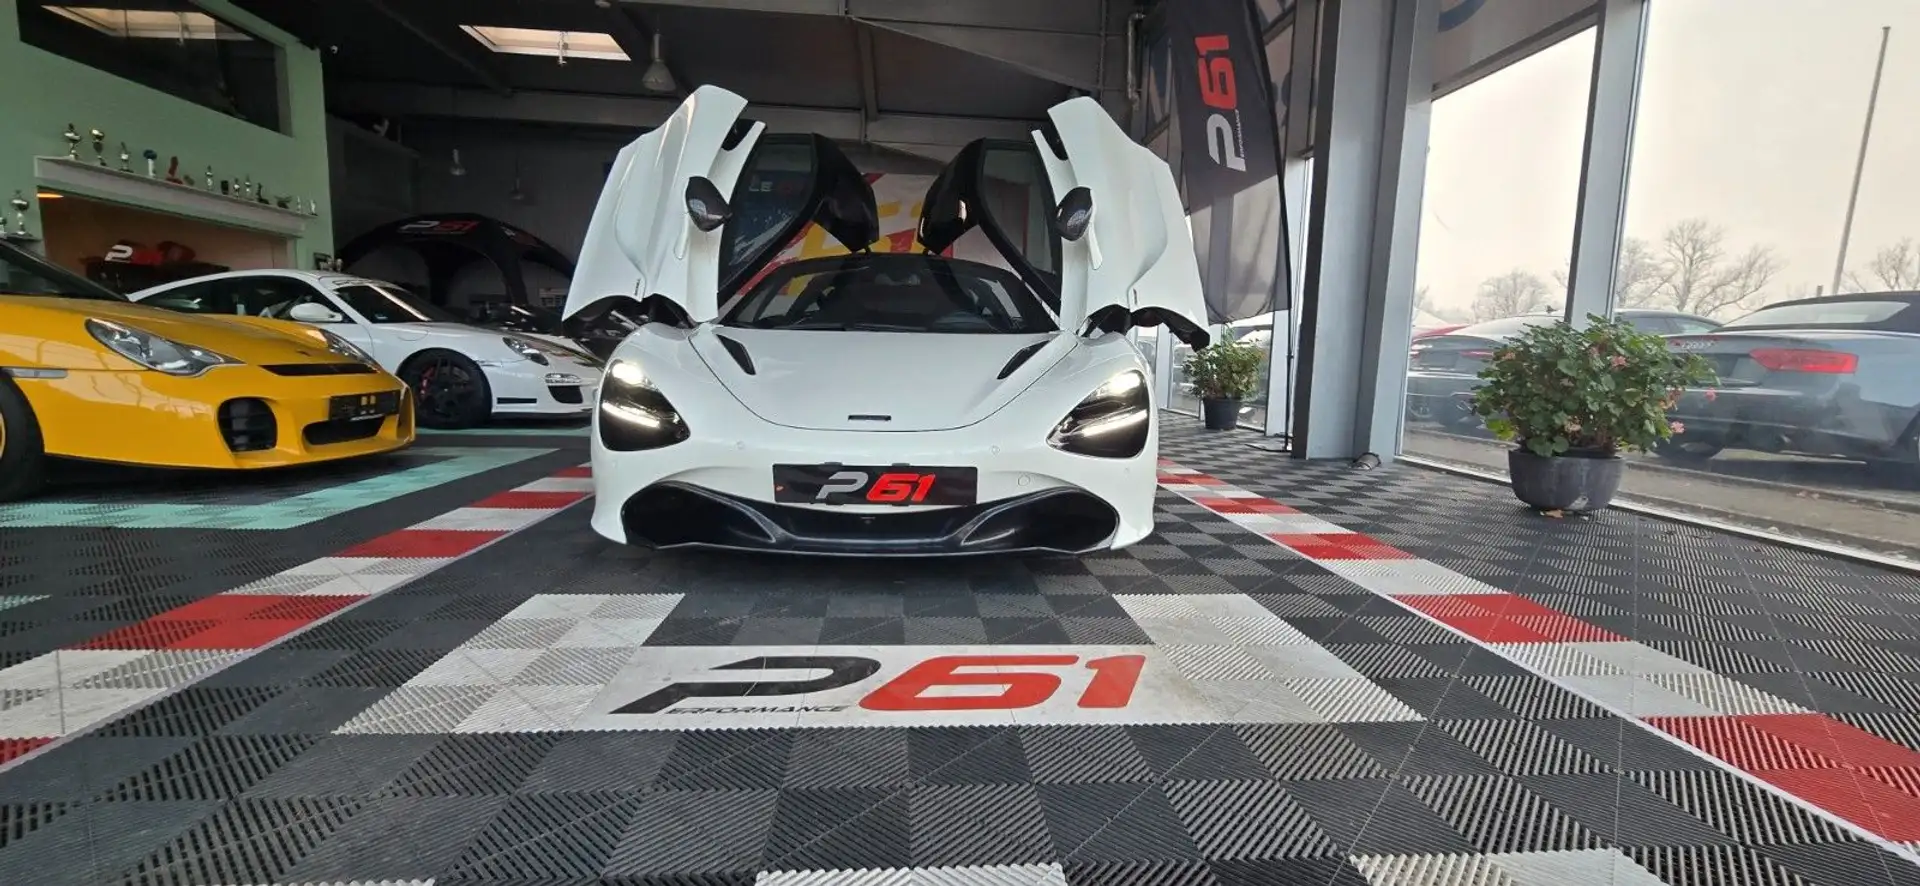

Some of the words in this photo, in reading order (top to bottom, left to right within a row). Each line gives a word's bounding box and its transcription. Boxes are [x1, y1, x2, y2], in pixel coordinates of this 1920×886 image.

[1195, 34, 1246, 172] P61
[815, 471, 936, 502] P61
[608, 654, 1146, 715] P61
